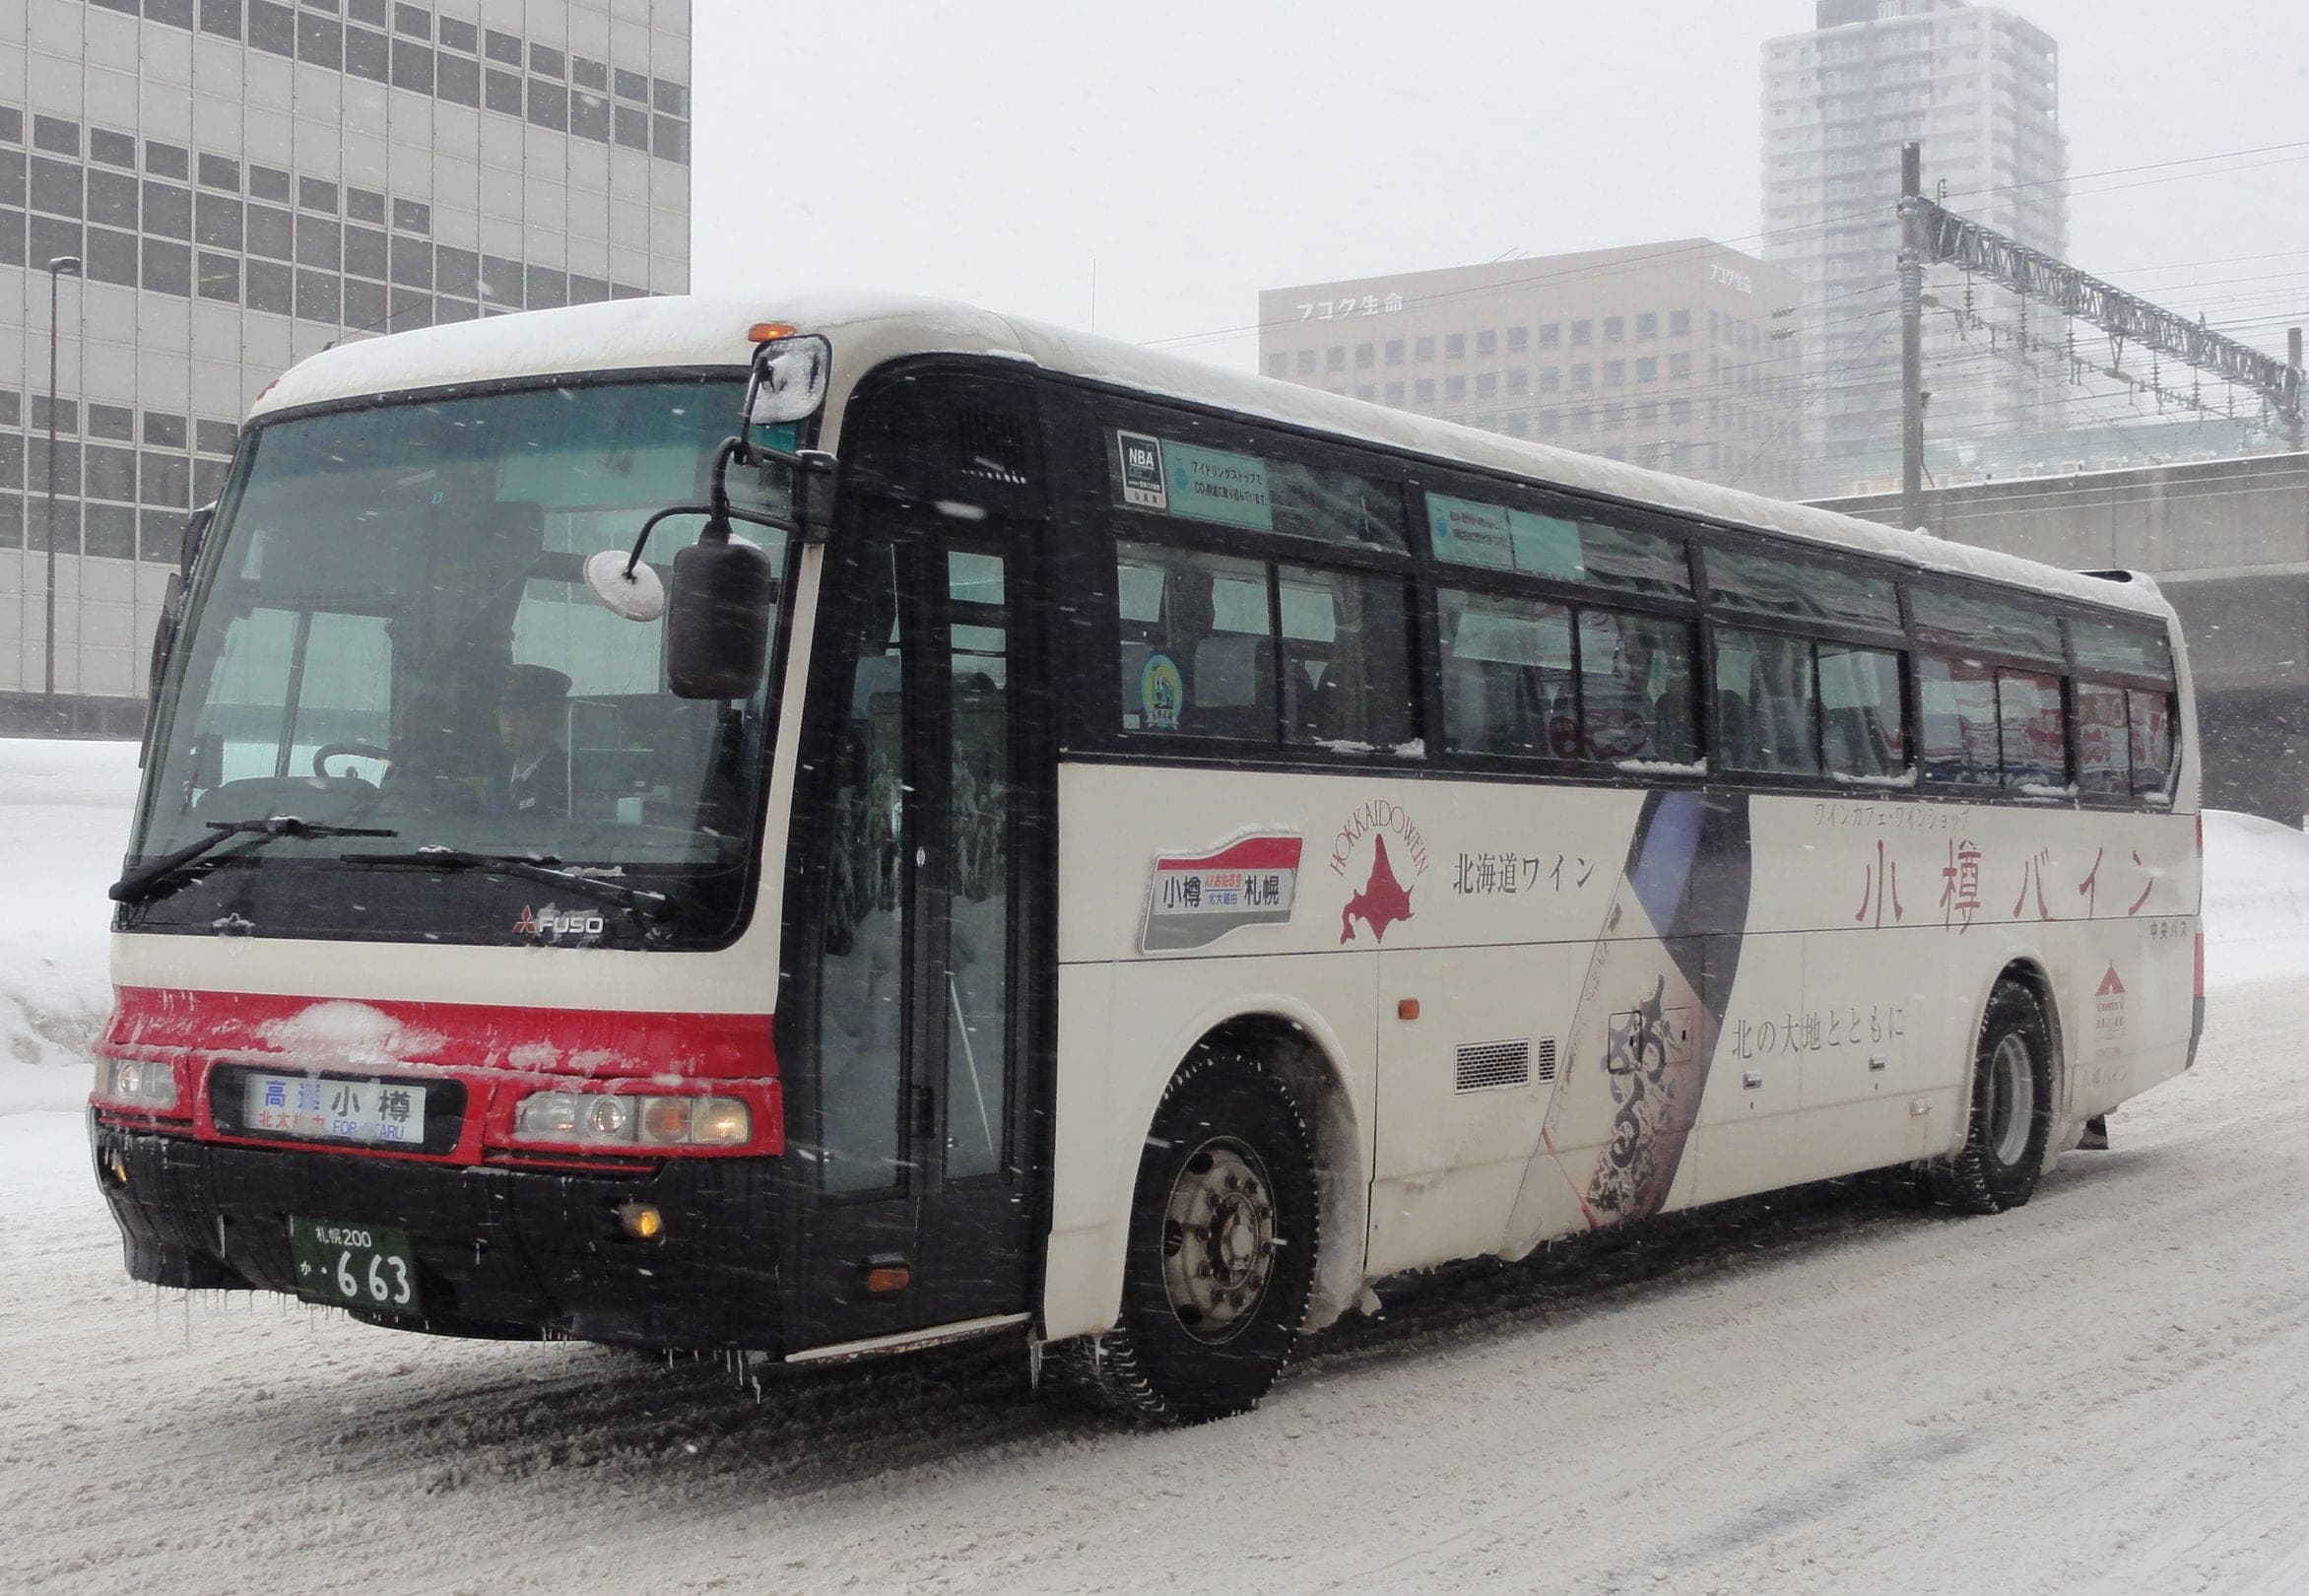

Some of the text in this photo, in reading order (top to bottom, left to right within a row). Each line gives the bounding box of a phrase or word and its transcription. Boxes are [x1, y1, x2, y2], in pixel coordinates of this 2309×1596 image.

[1710, 263, 1751, 295] フコク生命
[1296, 293, 1404, 322] フコク生命
[1129, 447, 1154, 468] NBA
[1192, 461, 1262, 486] アイドリングストップで
[1453, 851, 1596, 896] 北海道ワイン
[1855, 839, 2153, 934] 小樽バイン
[1163, 875, 1201, 908] 小樽
[1244, 875, 1280, 906] 札幌
[539, 916, 604, 934] FUSO
[1732, 1005, 1903, 1061] 北の大地とともに
[331, 1085, 412, 1124] 小樽
